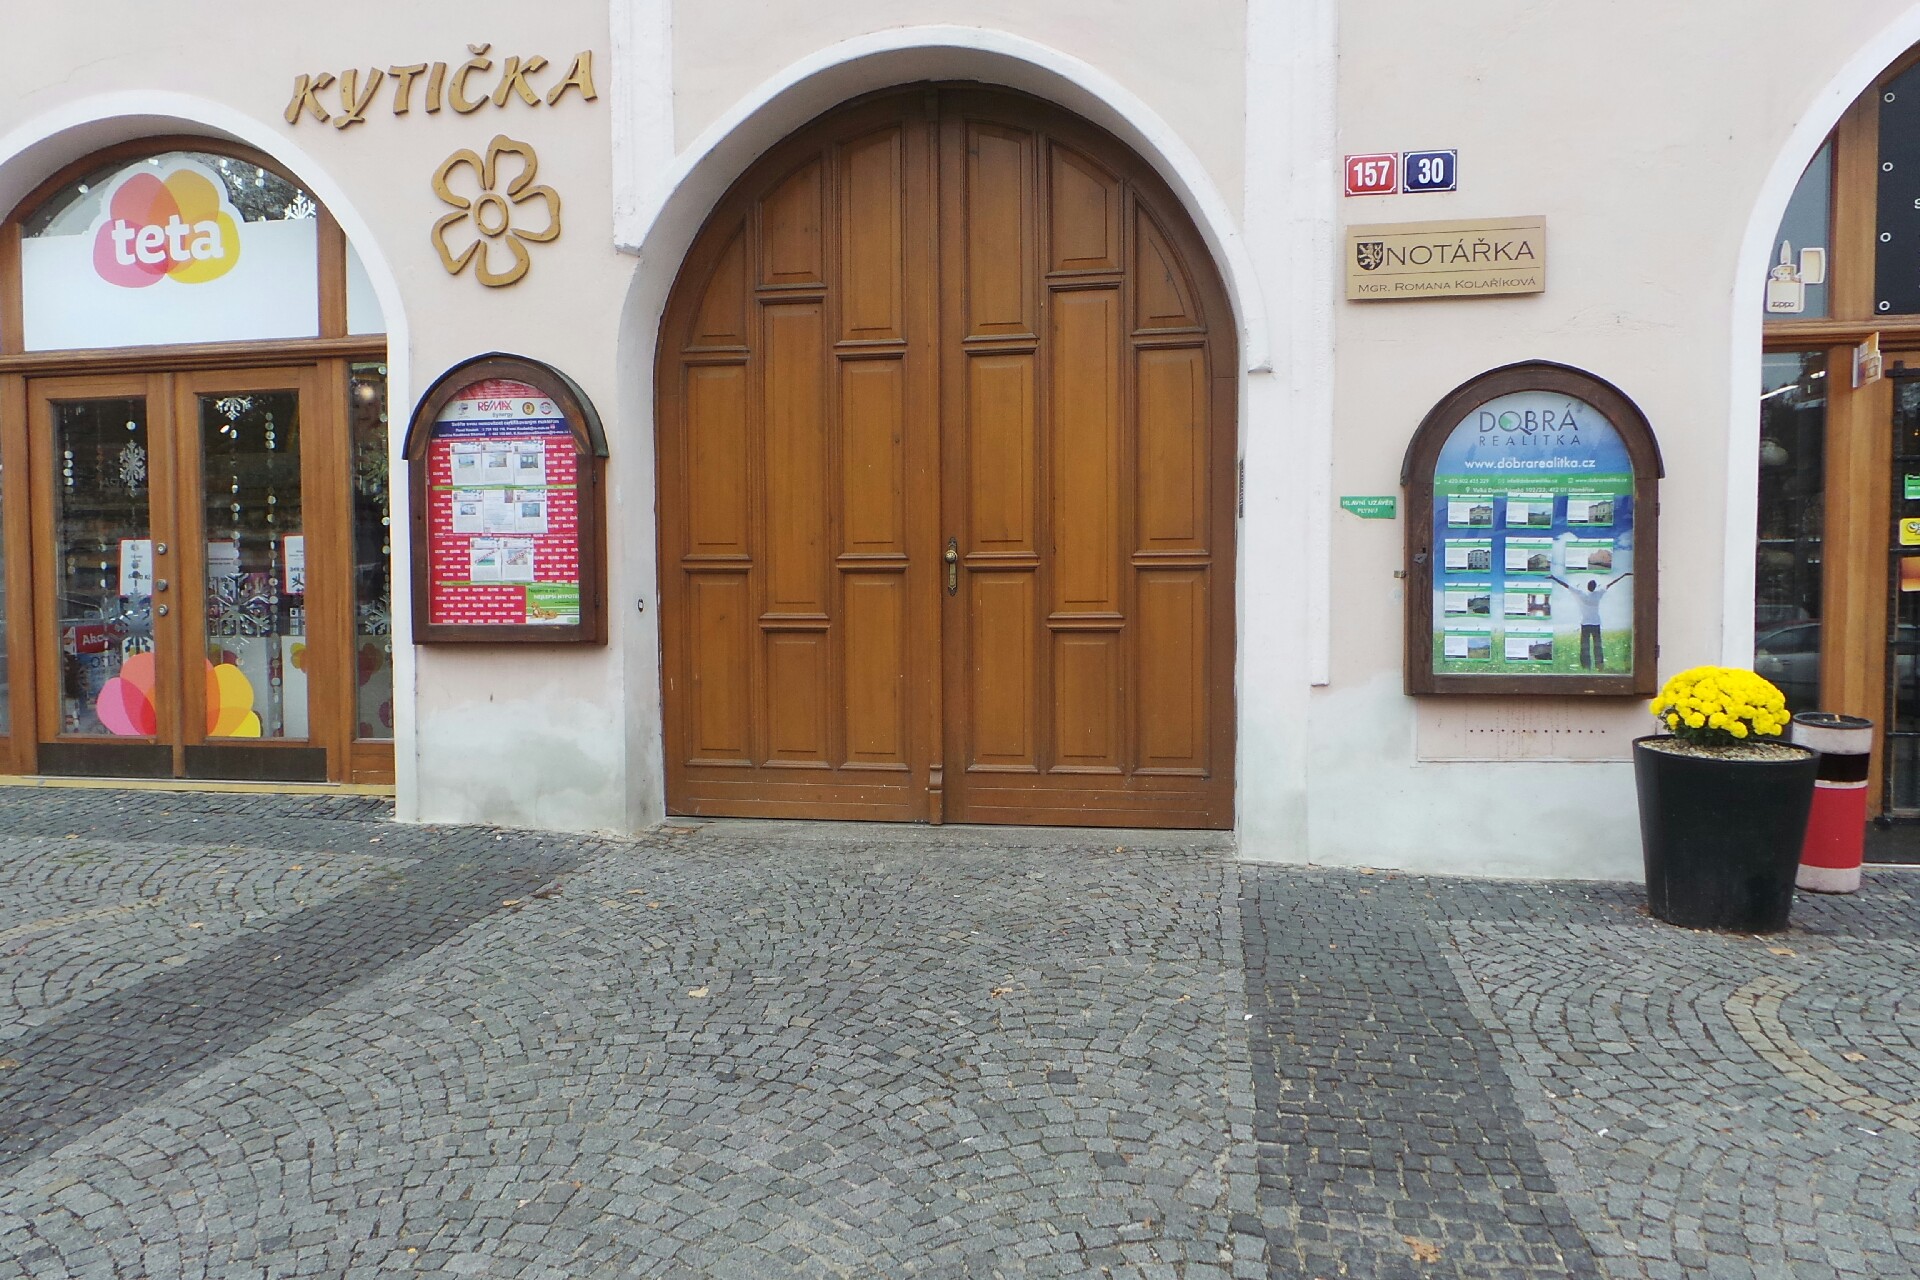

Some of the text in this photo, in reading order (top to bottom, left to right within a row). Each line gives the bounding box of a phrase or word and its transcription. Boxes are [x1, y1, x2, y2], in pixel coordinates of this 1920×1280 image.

[284, 43, 597, 130] KYTIČKA
[1353, 160, 1390, 187] 157
[1418, 157, 1444, 184] 30
[112, 214, 224, 265] teta
[1386, 238, 1535, 266] NOTÁŘKA
[477, 400, 513, 411] RE/MAX
[1479, 403, 1579, 435] DOBRÁ
[1479, 434, 1581, 447] REALITKA
[1465, 456, 1596, 469] www.dobrarealitka.cz
